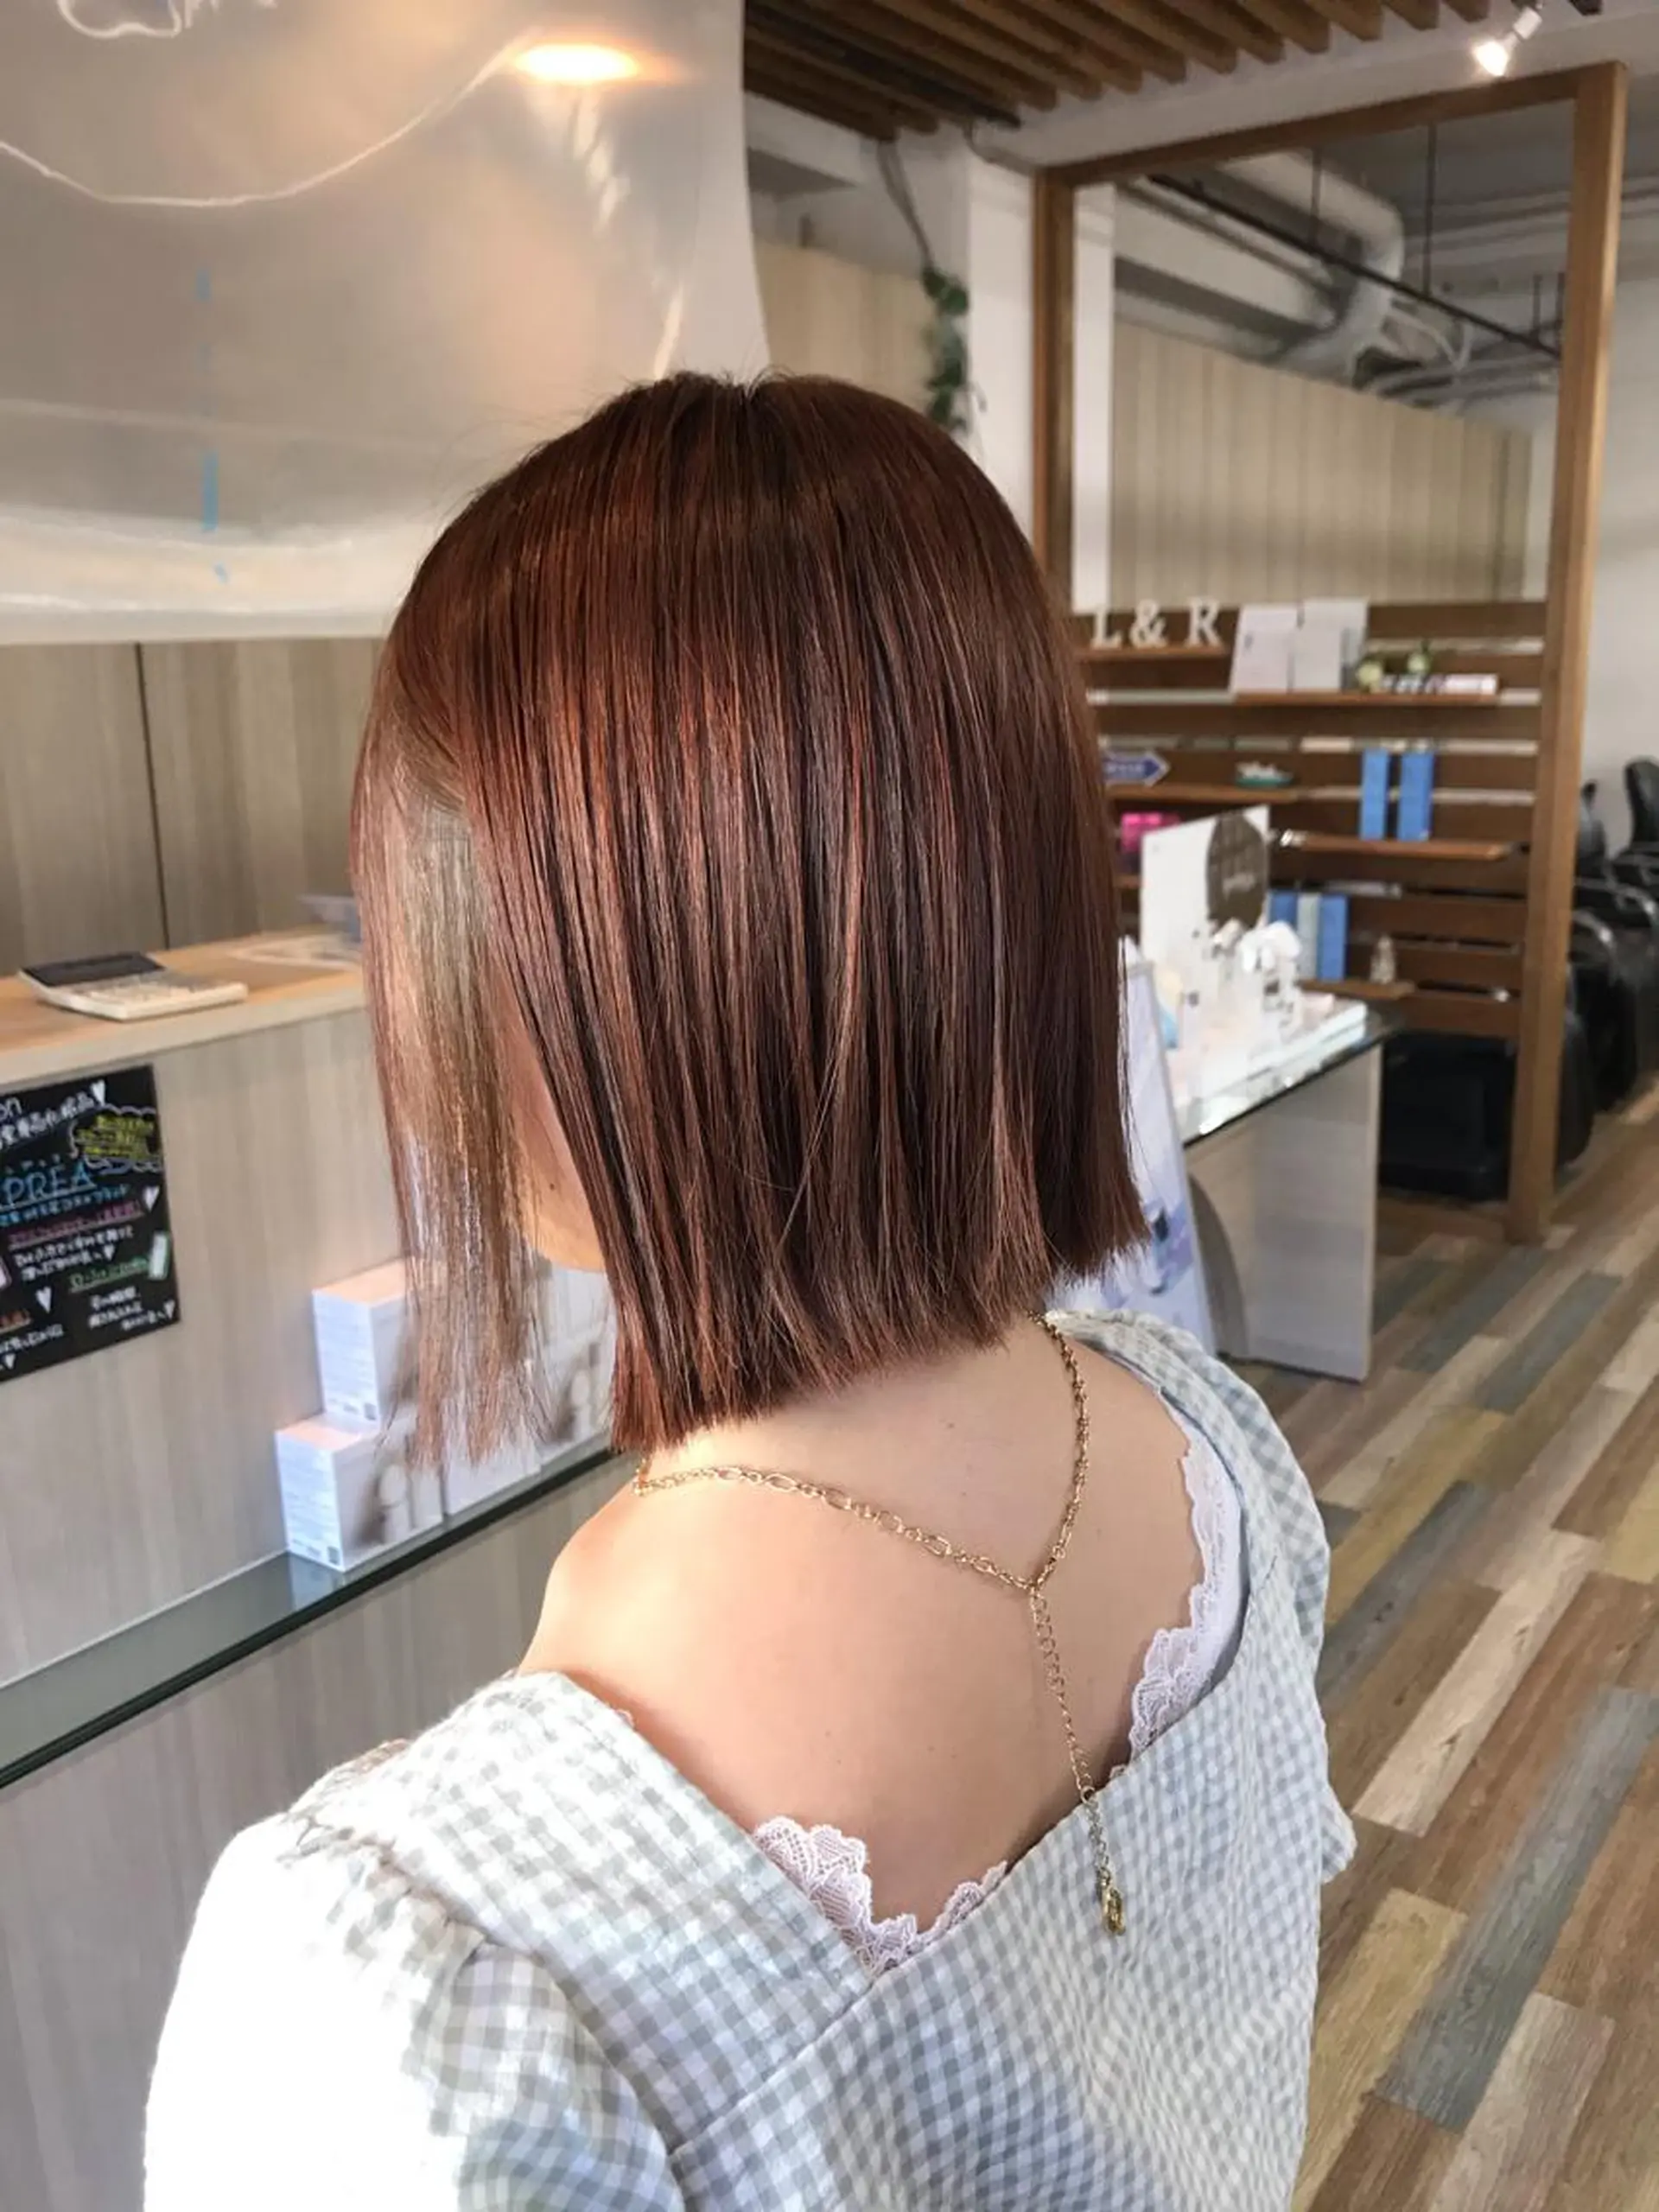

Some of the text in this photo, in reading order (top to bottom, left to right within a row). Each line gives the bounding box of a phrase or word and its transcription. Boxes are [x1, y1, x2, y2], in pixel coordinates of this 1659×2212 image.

[1090, 595, 1224, 650] L & R
